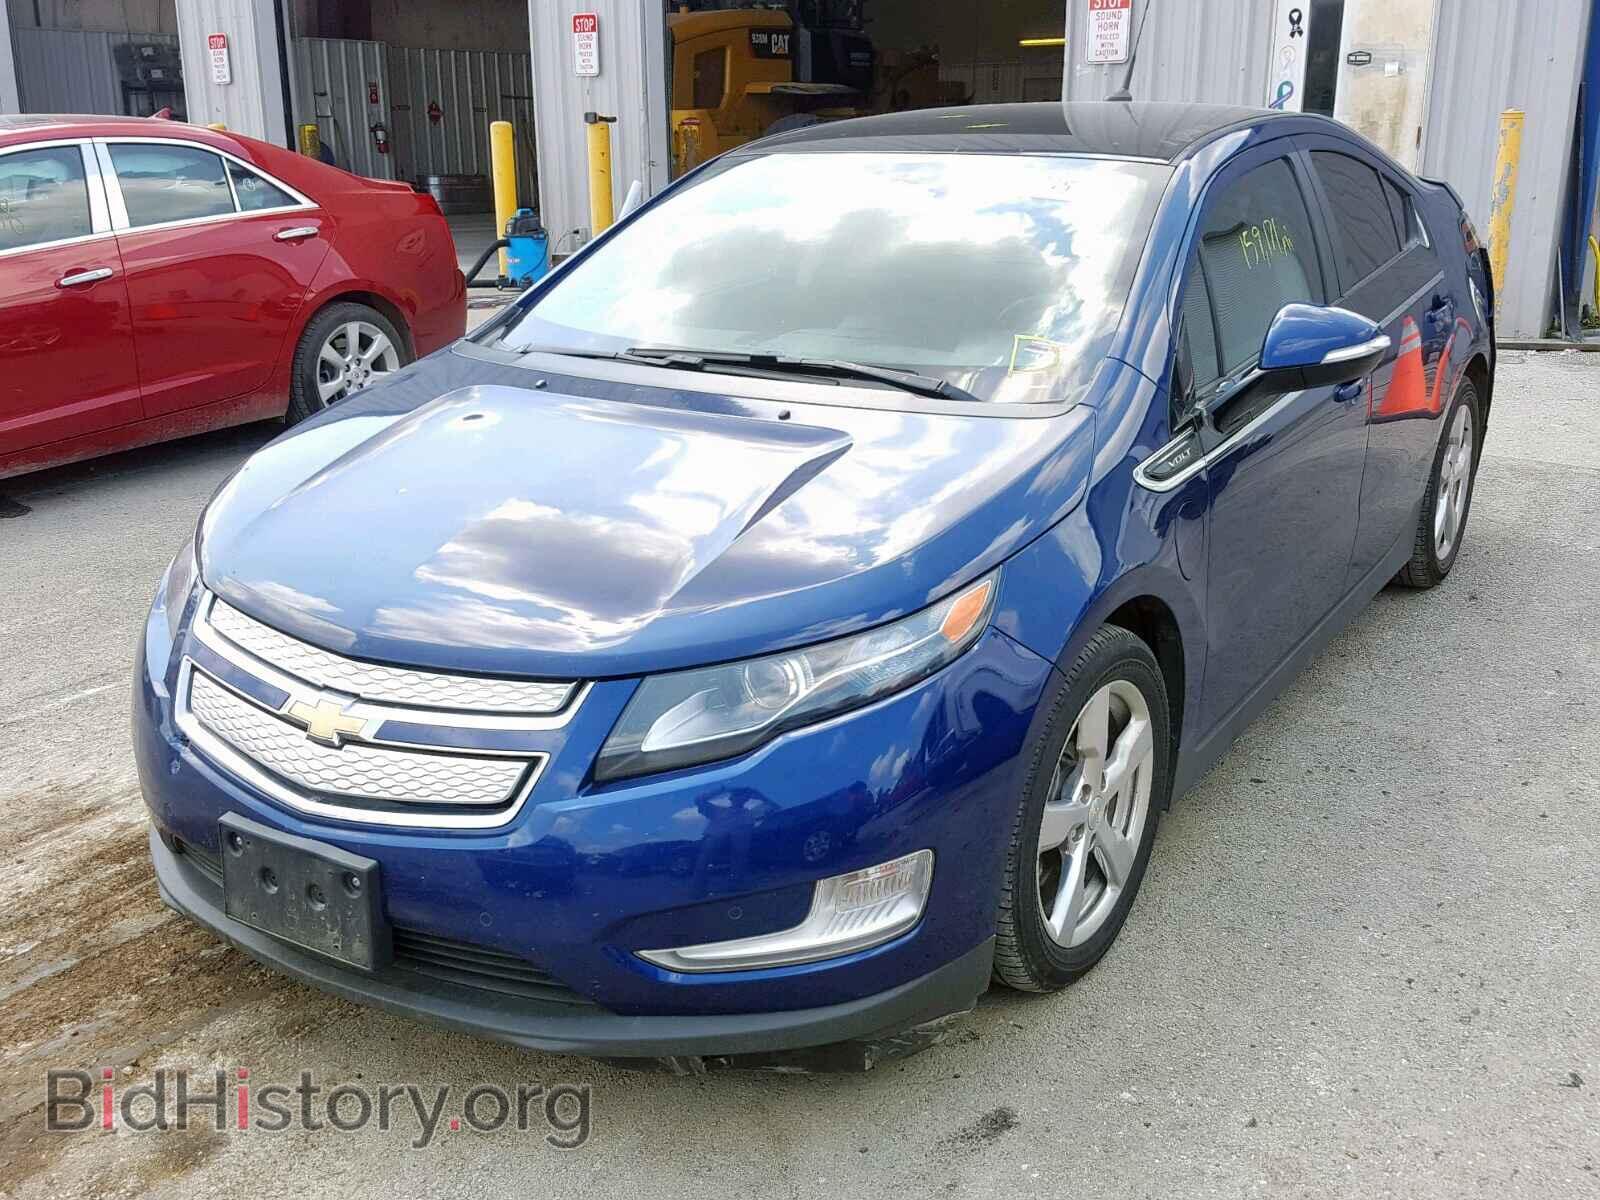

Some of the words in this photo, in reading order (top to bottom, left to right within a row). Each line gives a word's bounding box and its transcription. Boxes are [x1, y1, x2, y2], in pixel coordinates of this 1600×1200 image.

[1095, 11, 1122, 20] SOUND
[575, 18, 594, 32] STOP
[1097, 22, 1120, 31] HORN
[210, 37, 226, 49] STOP
[771, 34, 790, 54] CAT
[1168, 448, 1191, 467] VOLT
